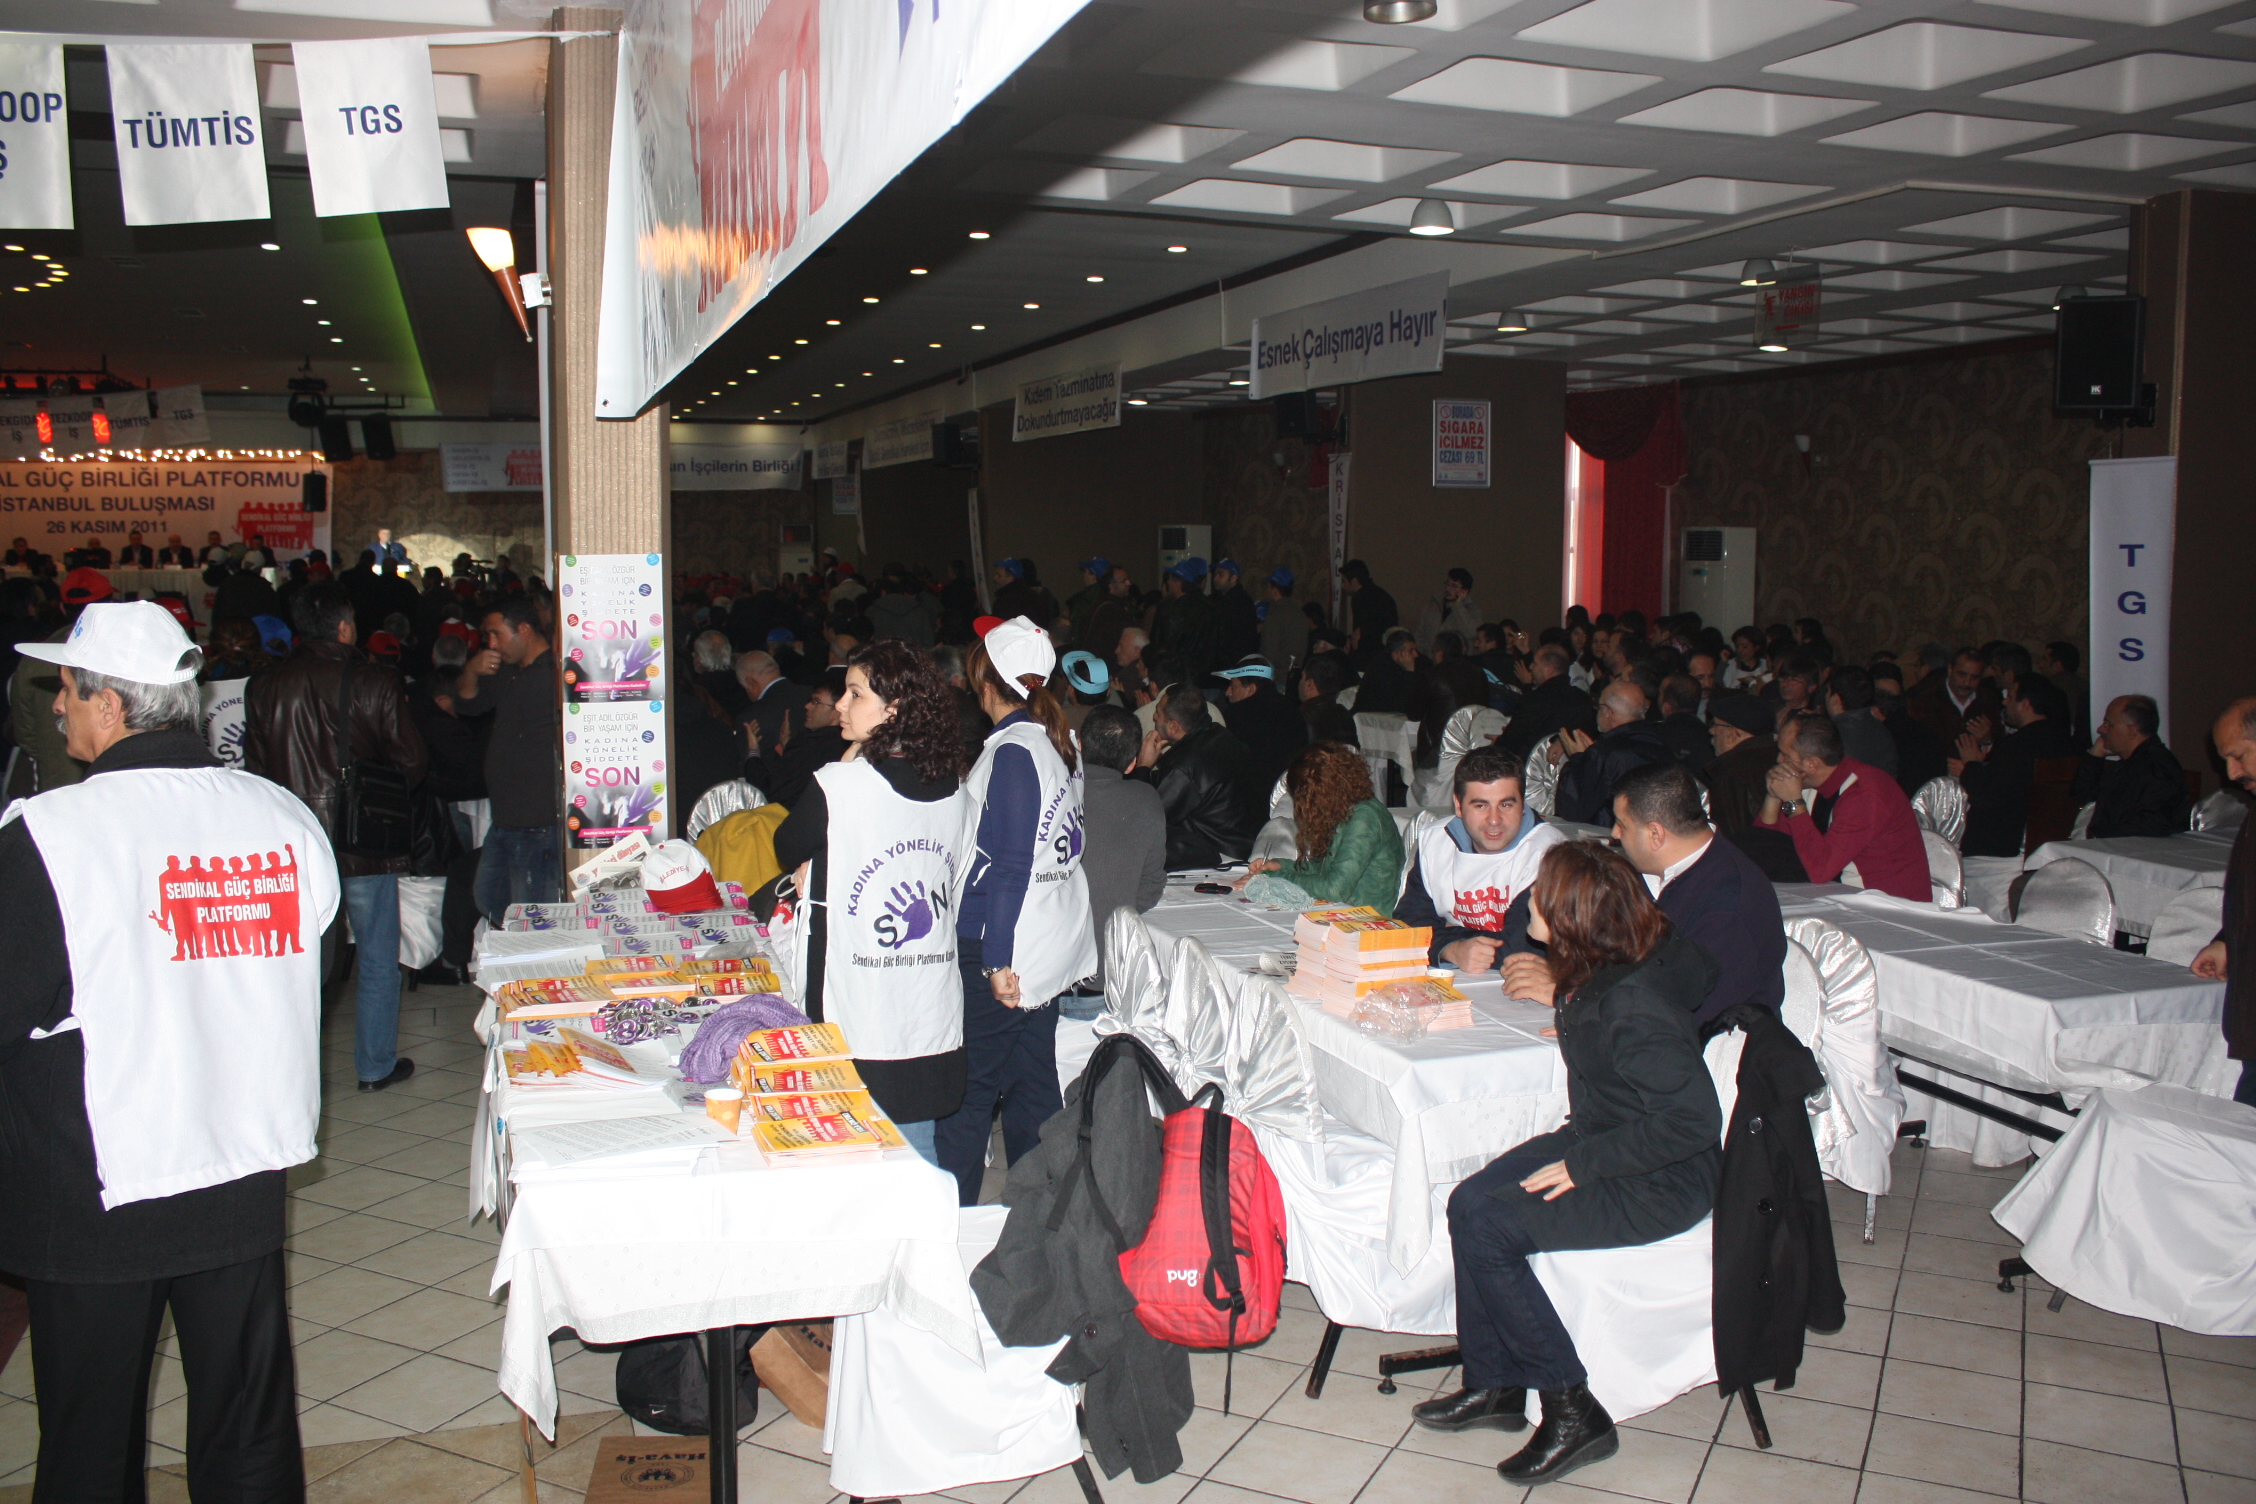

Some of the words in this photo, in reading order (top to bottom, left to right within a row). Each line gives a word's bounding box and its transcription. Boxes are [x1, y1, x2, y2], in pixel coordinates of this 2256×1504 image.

[122, 110, 255, 149] TÜMTİS
[338, 104, 403, 135] TGS
[1257, 333, 1301, 370] Esnek
[1303, 321, 1384, 370] Çalışmaya
[1390, 309, 1437, 347] Hayır
[1024, 385, 1052, 406] Kıdem
[110, 416, 150, 430] TÜMTİS
[173, 409, 194, 420] TGS
[1440, 420, 1484, 434] SİGARA
[690, 457, 748, 476] İşçilerin
[25, 467, 74, 493] GÜÇ
[81, 467, 159, 488] BİRLİĞİ
[166, 471, 300, 488] PLATFORMU
[101, 496, 215, 516] BULUŞMASI
[46, 520, 66, 534] 26
[71, 520, 126, 534] KASIM
[130, 520, 168, 534] 2011
[2117, 543, 2147, 662] TGS
[581, 619, 637, 640] SON
[616, 711, 638, 721] ÖZGÜR
[598, 724, 621, 733] YAŞAM
[624, 723, 639, 733] İÇİN
[585, 755, 639, 764] ŞİDDETE
[585, 766, 640, 787] SON
[1038, 787, 1067, 842] KADINA
[166, 878, 221, 900] SENDİKAL
[224, 876, 251, 900] GÜÇ
[253, 872, 294, 895] BİRLİĞİ
[848, 857, 885, 916] KADINA
[884, 838, 945, 859] YÖNELİK
[196, 902, 271, 923] PLATFORMU
[851, 953, 882, 969] Sendikal
[895, 954, 915, 967] Birliği
[1166, 1269, 1198, 1287] pug
